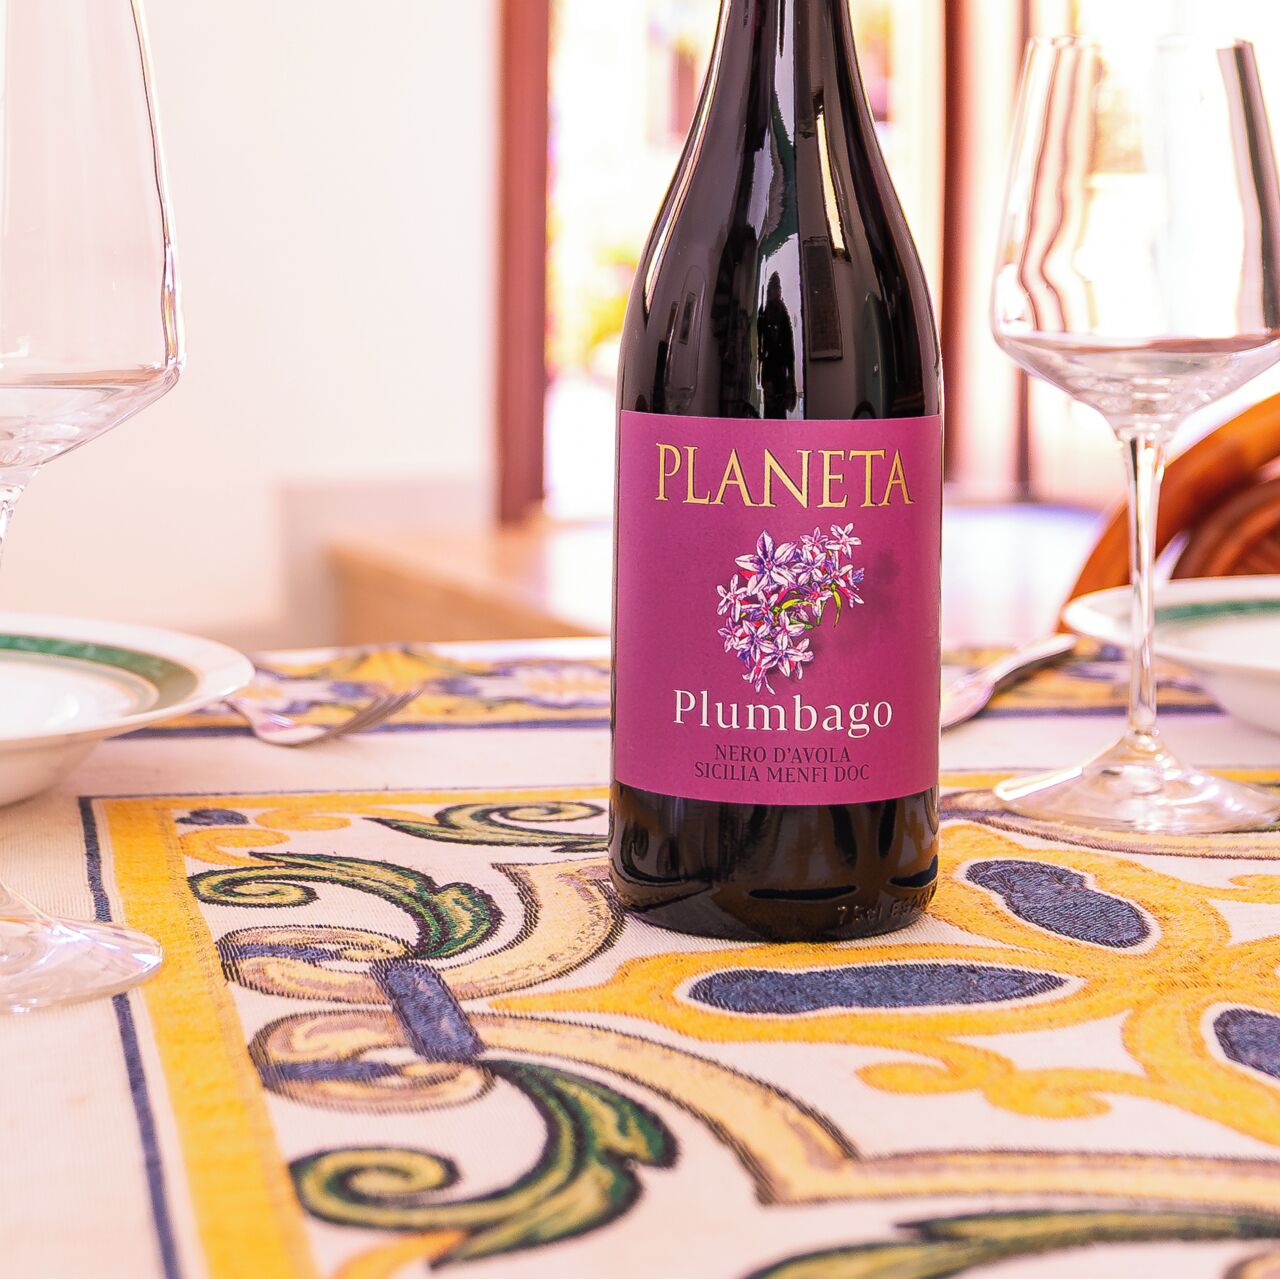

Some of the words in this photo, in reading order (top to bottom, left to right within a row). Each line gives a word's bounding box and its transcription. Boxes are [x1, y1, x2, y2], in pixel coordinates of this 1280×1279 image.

[655, 442, 914, 508] PLANETA
[673, 689, 893, 738] Plumbago
[715, 744, 767, 763] NERO
[773, 746, 852, 763] D'AVOLA
[694, 762, 761, 783] SICILIA
[766, 766, 829, 784] MENFI
[834, 764, 870, 782] DOC
